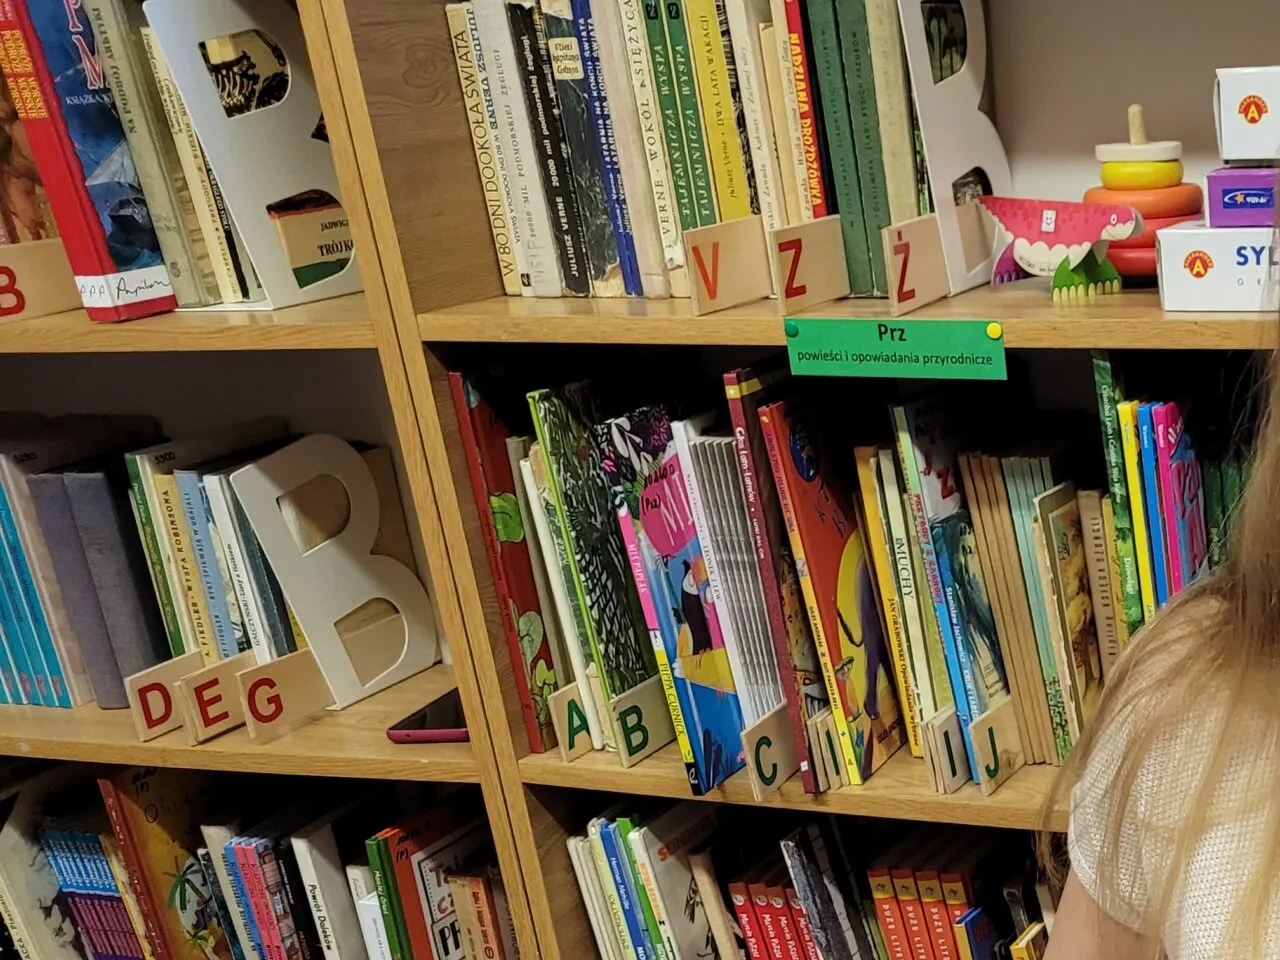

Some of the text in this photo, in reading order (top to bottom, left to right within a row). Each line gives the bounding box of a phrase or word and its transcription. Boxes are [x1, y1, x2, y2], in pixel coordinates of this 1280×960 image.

[466, 8, 499, 130] JULIUSZ VERNE
[708, 69, 721, 98] LATA
[788, 32, 810, 115] NADZIANA
[453, 30, 514, 277] W 80 DNI DOOKOŁA ŚWIATA
[504, 104, 525, 178] PODMORSKIEJ
[520, 34, 579, 278] JULIUSZ VERNE 20000 mil podmorskiej żeglugi
[653, 45, 691, 216] TAJEMNICZA WYSPA
[674, 45, 711, 216] TAJEMNICZA WYSPA
[654, 178, 671, 236] VERNE
[691, 241, 719, 300] V
[778, 237, 807, 299] Z
[893, 230, 916, 304] Ż
[797, 348, 993, 368] powieści opowiadania przyrodnicze
[876, 323, 907, 344] Prz
[162, 490, 208, 646] FIEDLER ROBINSONA
[247, 677, 284, 724] G
[660, 662, 686, 738] PIPPA CURNICK
[887, 597, 919, 747] JAN GRABOWSKI Opowiadania wybrane
[138, 681, 172, 730] D
[193, 677, 229, 728] E
[567, 698, 590, 751] A
[618, 704, 649, 757] B
[753, 735, 779, 787] C
[984, 726, 1000, 779] J
[308, 884, 333, 952] Powrót Daleków
[881, 903, 896, 931] DUŻE
[905, 904, 919, 932] DUŻE
[929, 906, 944, 934] DUŻE
